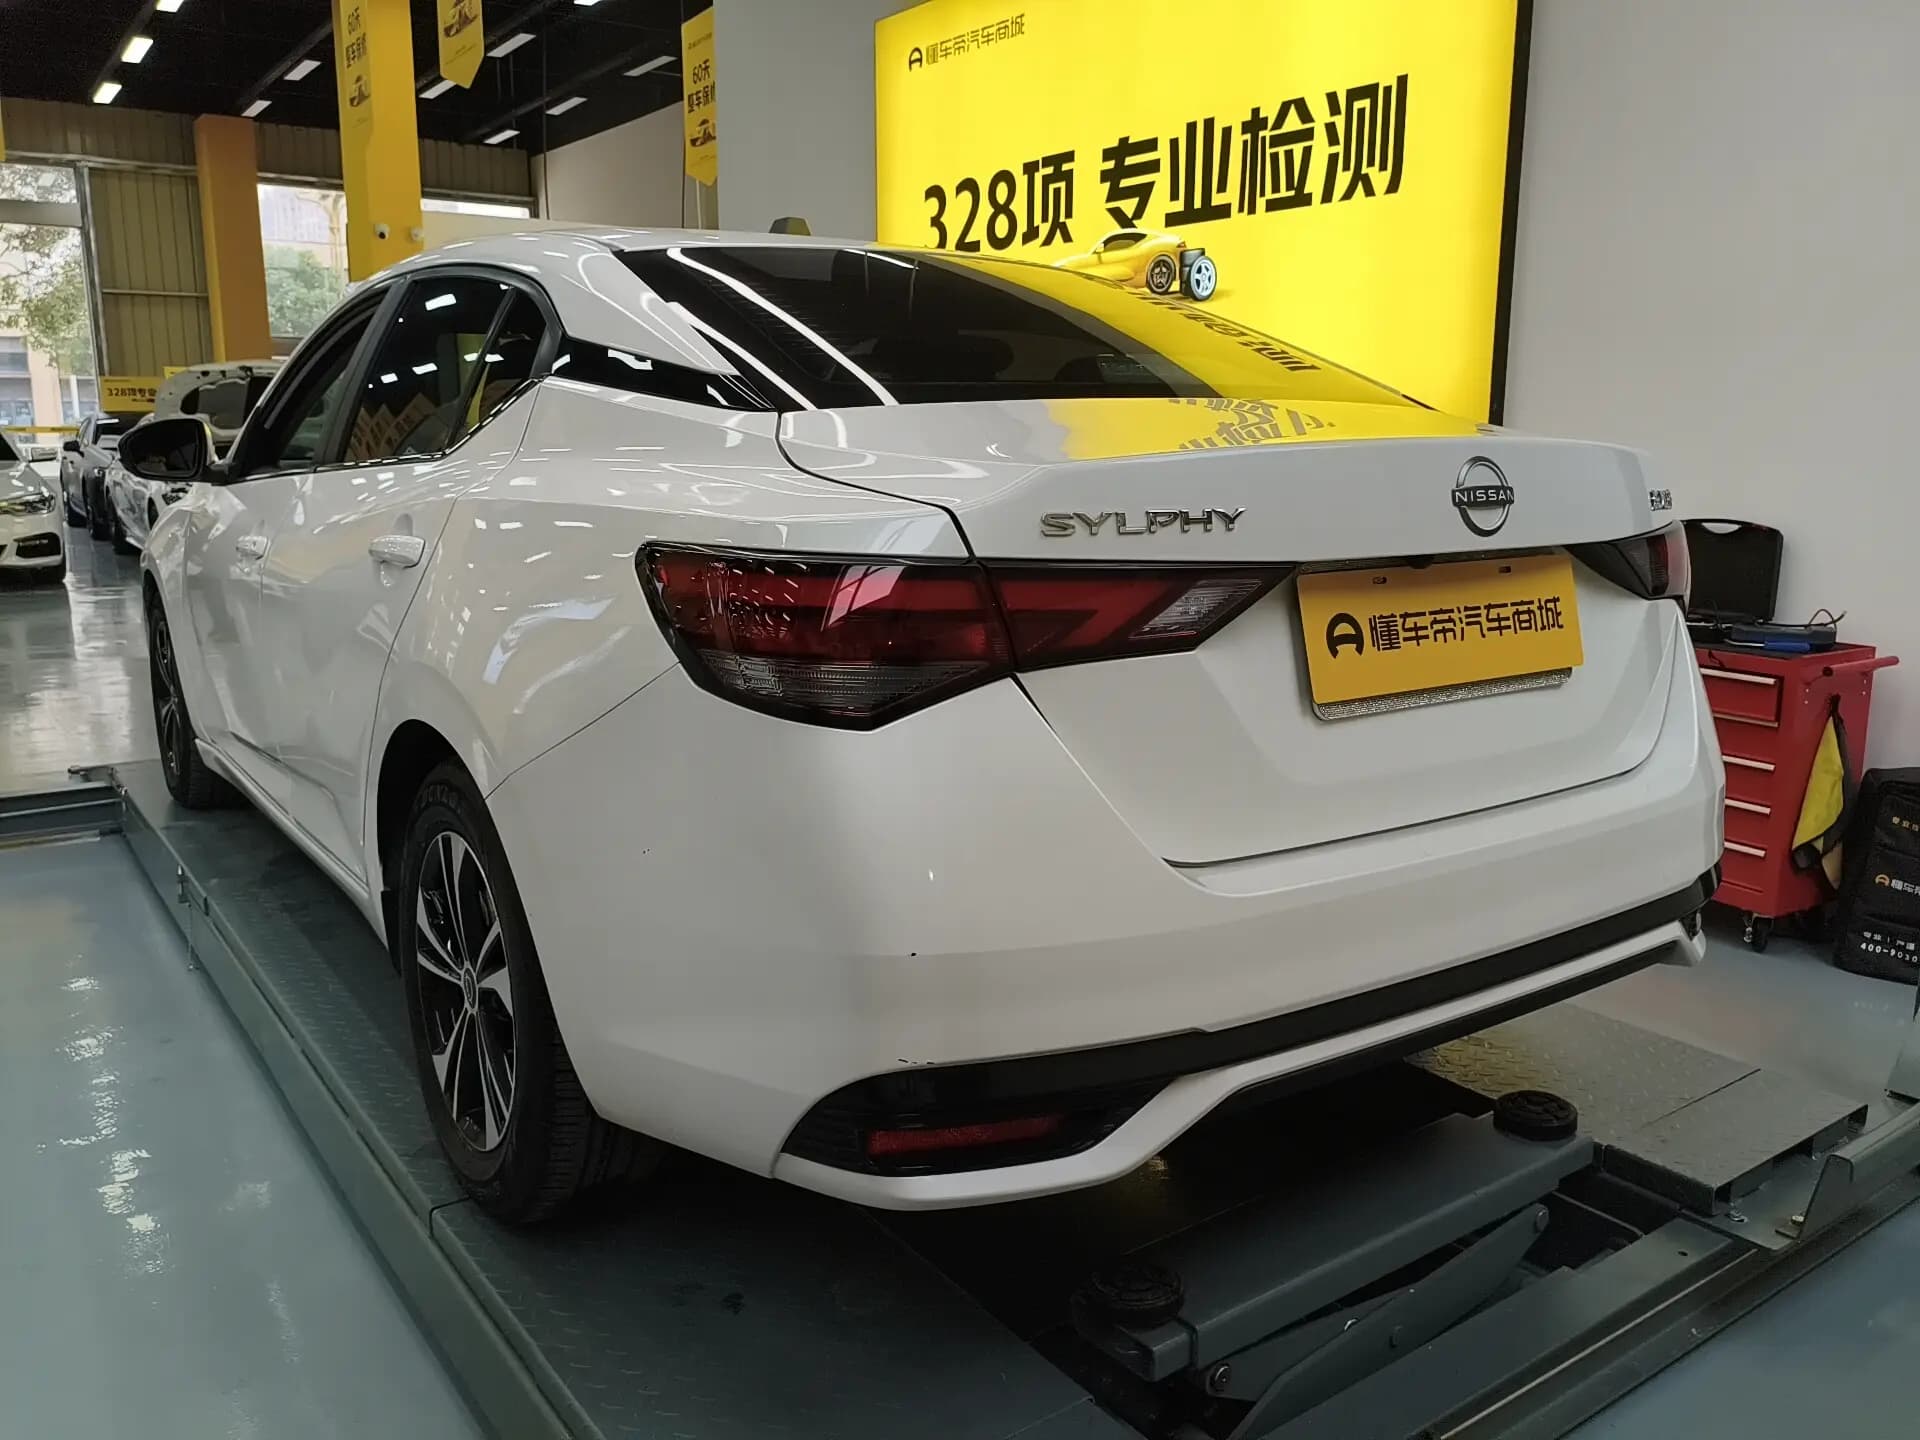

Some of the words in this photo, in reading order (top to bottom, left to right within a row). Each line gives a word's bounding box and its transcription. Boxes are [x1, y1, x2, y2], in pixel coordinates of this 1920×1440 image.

[925, 13, 1026, 66] 懂车帝汽车商城
[692, 58, 711, 85] 60天
[924, 149, 1076, 253] 328项
[1099, 73, 1409, 230] 专业检测
[1455, 489, 1515, 503] NISSAN
[1040, 507, 1248, 537] SYLPHY
[1368, 595, 1564, 652] 懂车帝汽车商城
